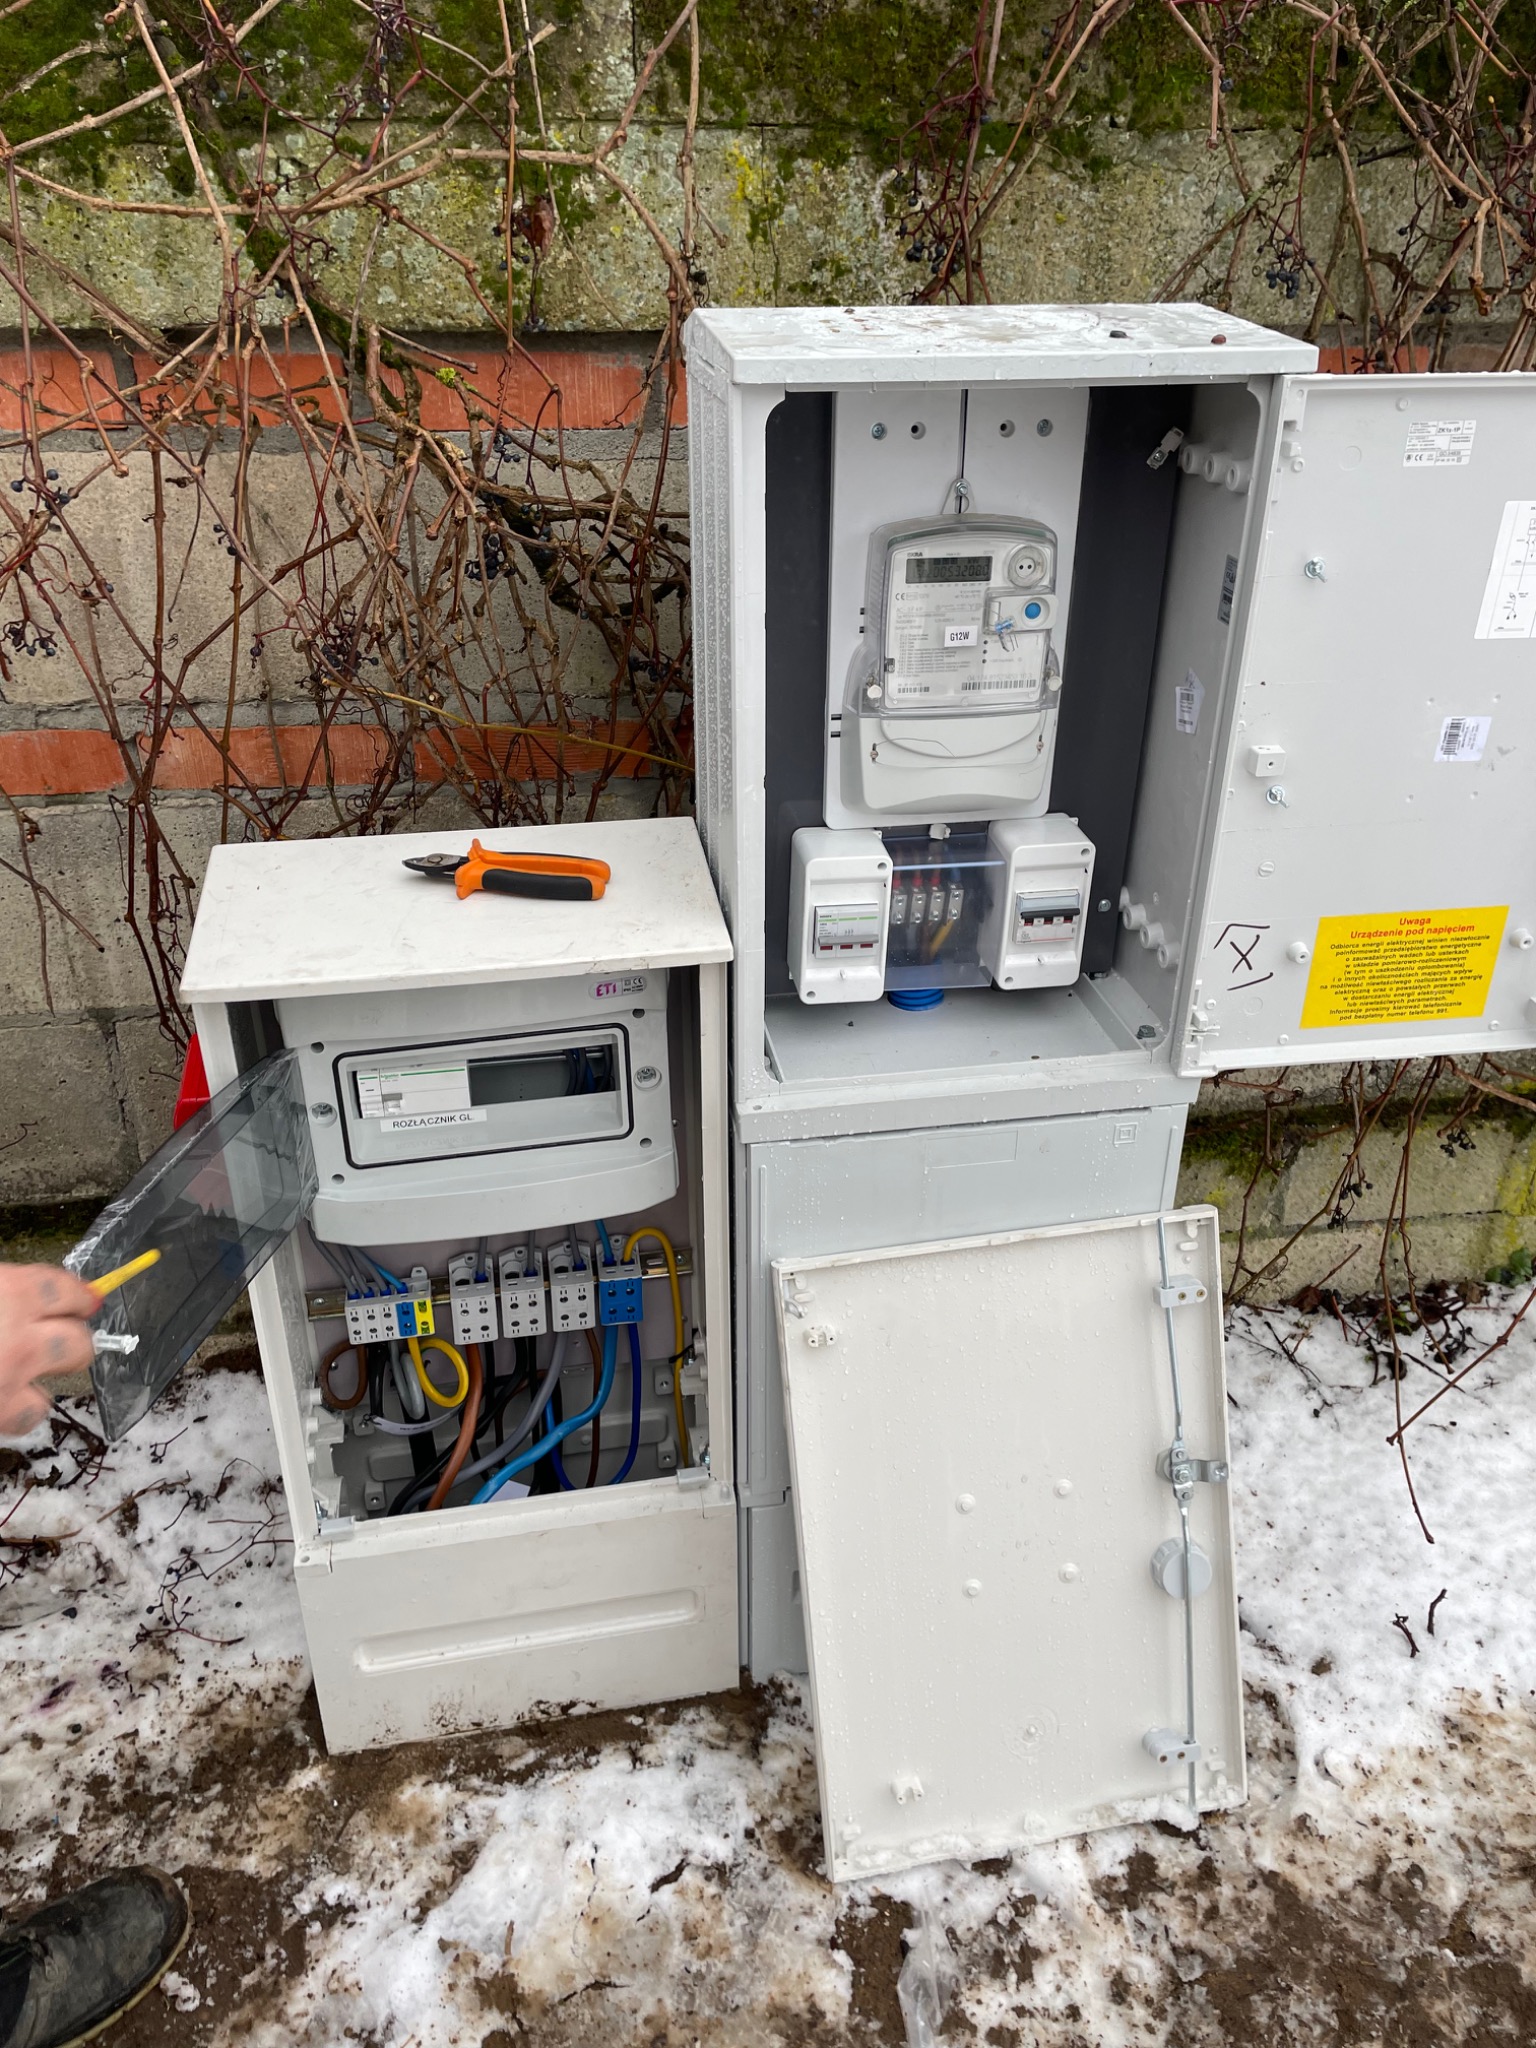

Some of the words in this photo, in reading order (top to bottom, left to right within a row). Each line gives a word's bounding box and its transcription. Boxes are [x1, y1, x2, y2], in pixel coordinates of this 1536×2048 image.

[950, 631, 970, 642] G12W
[1400, 918, 1431, 926] Uwaga
[1350, 929, 1403, 939] Urządzenie
[1405, 928, 1424, 937] pod
[1426, 925, 1475, 935] napięciem
[1336, 947, 1380, 956] poinformować
[1383, 944, 1437, 954] przedsiębiorstwo
[596, 982, 616, 997] ETI
[1433, 981, 1466, 990] przerwach
[392, 1114, 456, 1129] ROZŁĄCZNIK
